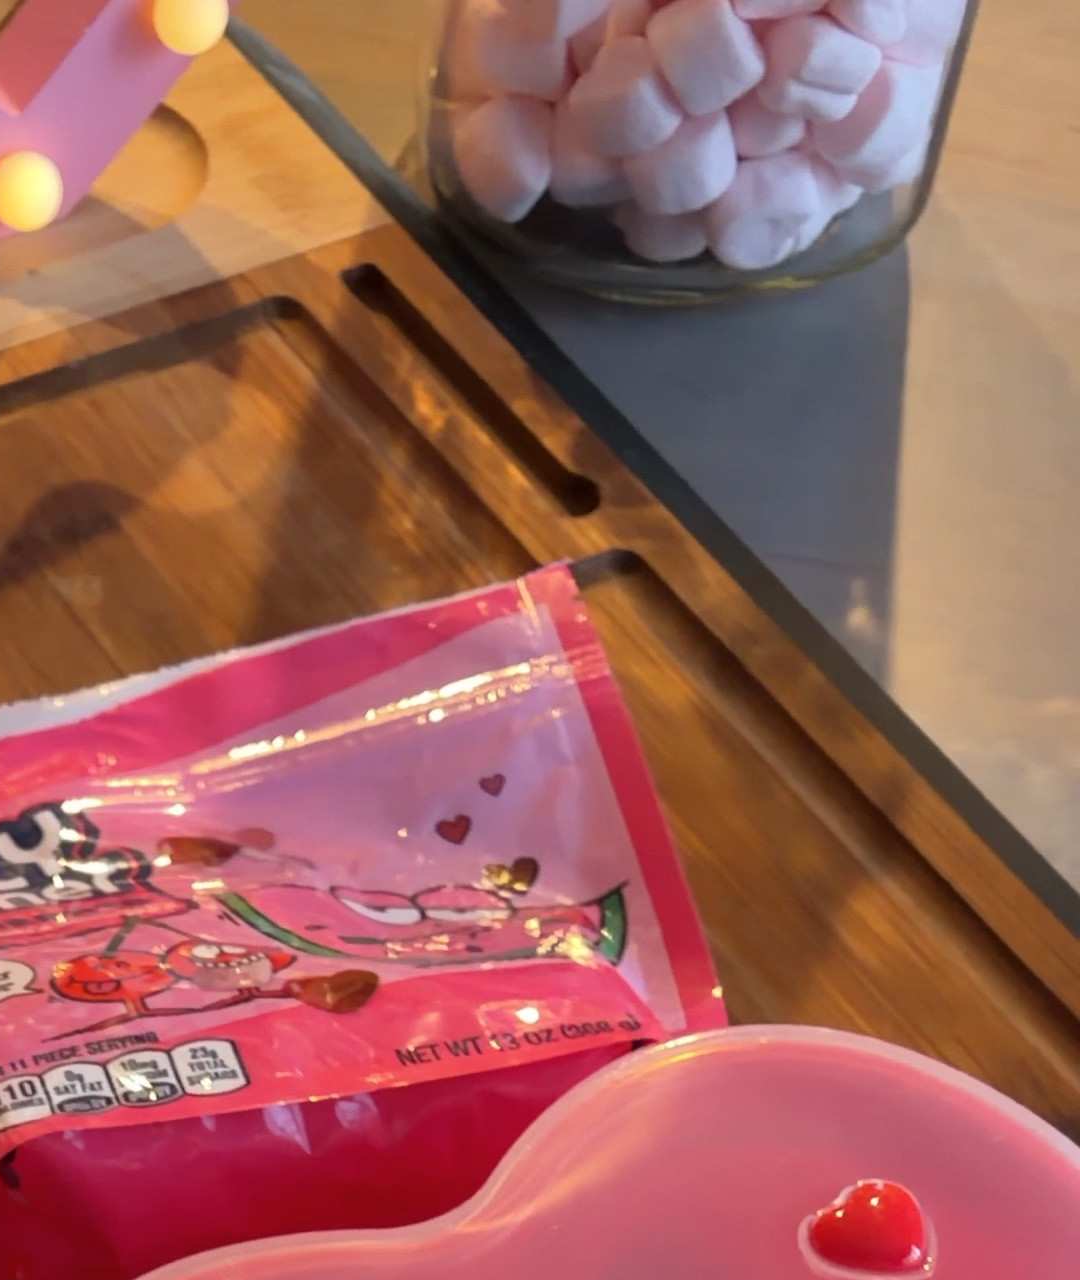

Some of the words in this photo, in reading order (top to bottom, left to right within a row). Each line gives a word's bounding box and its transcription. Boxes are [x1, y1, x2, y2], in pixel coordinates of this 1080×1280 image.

[11, 1060, 26, 1071] 11
[32, 1047, 81, 1067] PIECE
[84, 1031, 160, 1056] SERVING
[188, 1046, 219, 1060] 23g
[395, 1043, 441, 1067] NET
[445, 1037, 483, 1057] WT
[490, 1034, 519, 1052] 13
[523, 1029, 560, 1045] OZ
[187, 1058, 229, 1071] TOTAL
[55, 1085, 77, 1096] SAT
[81, 1081, 104, 1093] FAT
